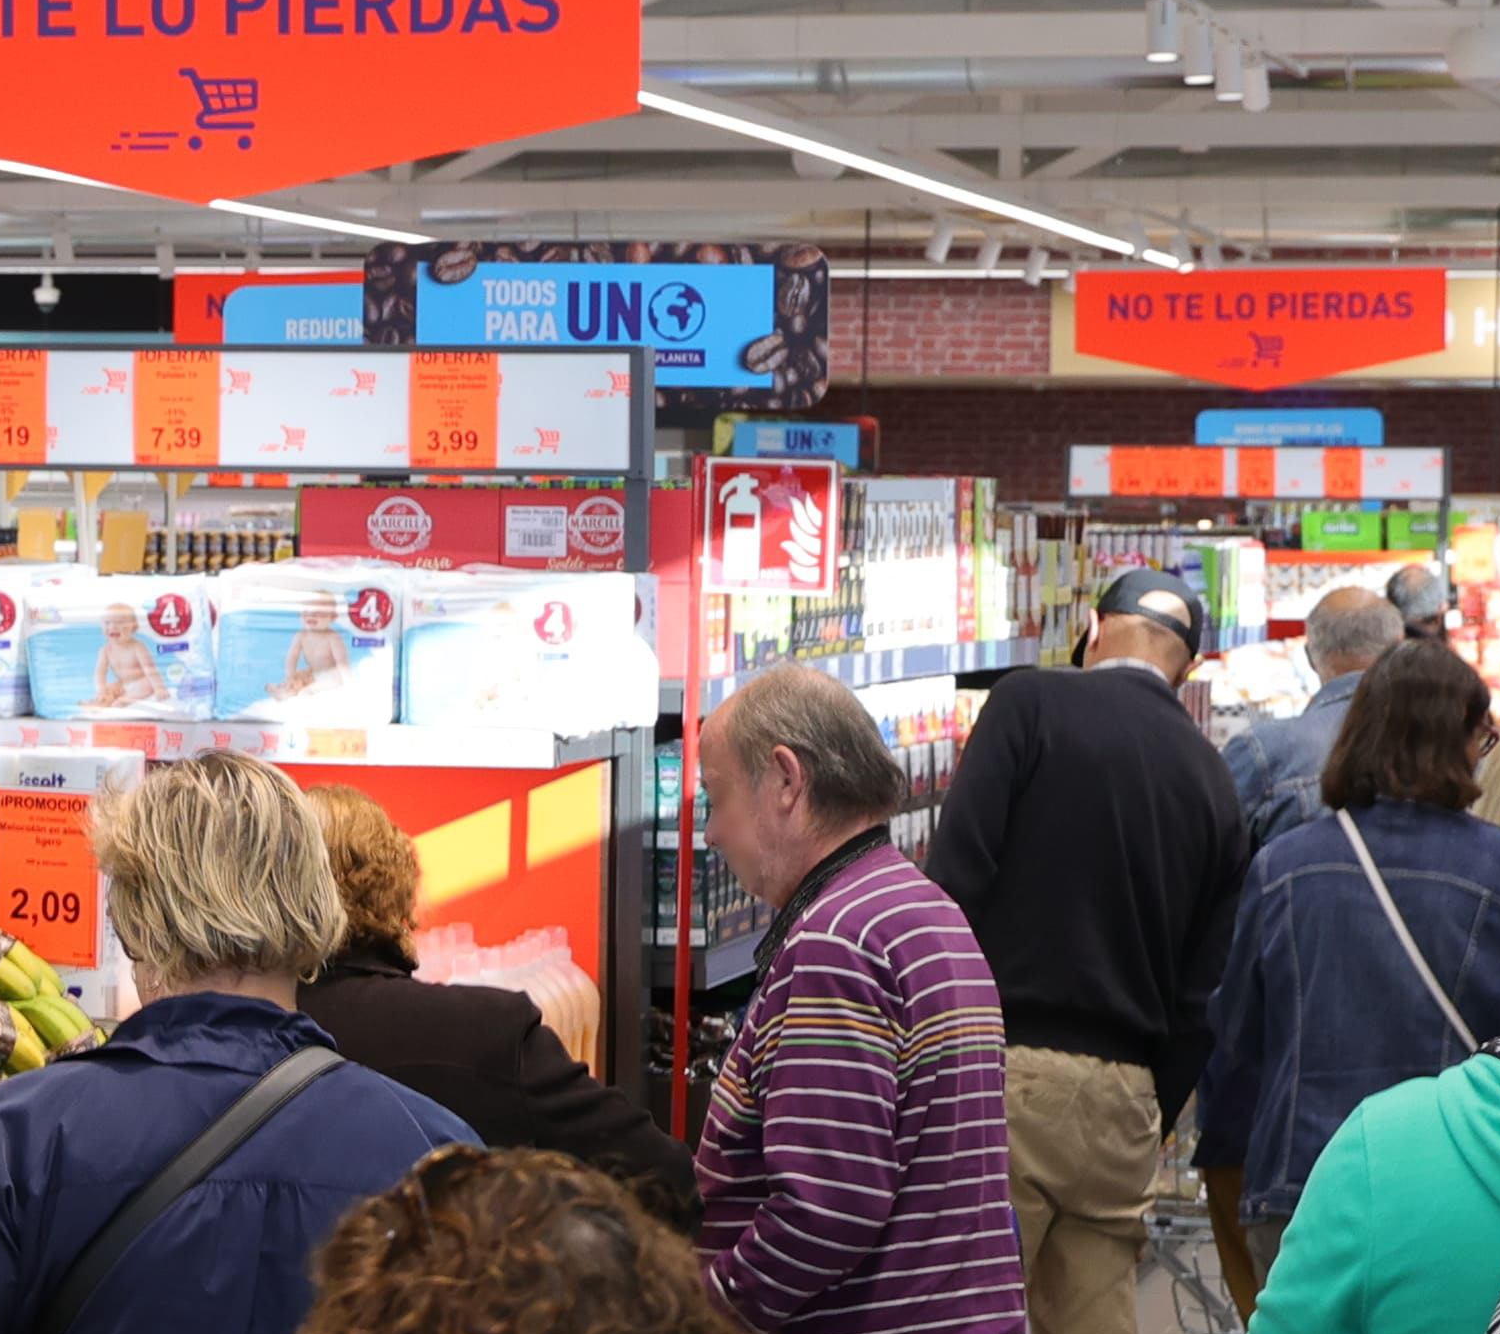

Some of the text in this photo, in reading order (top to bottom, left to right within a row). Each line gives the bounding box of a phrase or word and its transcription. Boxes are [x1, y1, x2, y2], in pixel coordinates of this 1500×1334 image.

[482, 280, 557, 307] TODOS
[1107, 292, 1415, 320] NO TE LO PIERDAS
[485, 310, 560, 342] PARA
[151, 427, 201, 451] 7,39
[427, 430, 479, 454] 3,99
[370, 517, 430, 529] MARCILLA
[569, 517, 623, 529] MARCILL
[159, 599, 181, 628] 4
[360, 594, 380, 624] 4
[10, 887, 81, 927] 2,09
